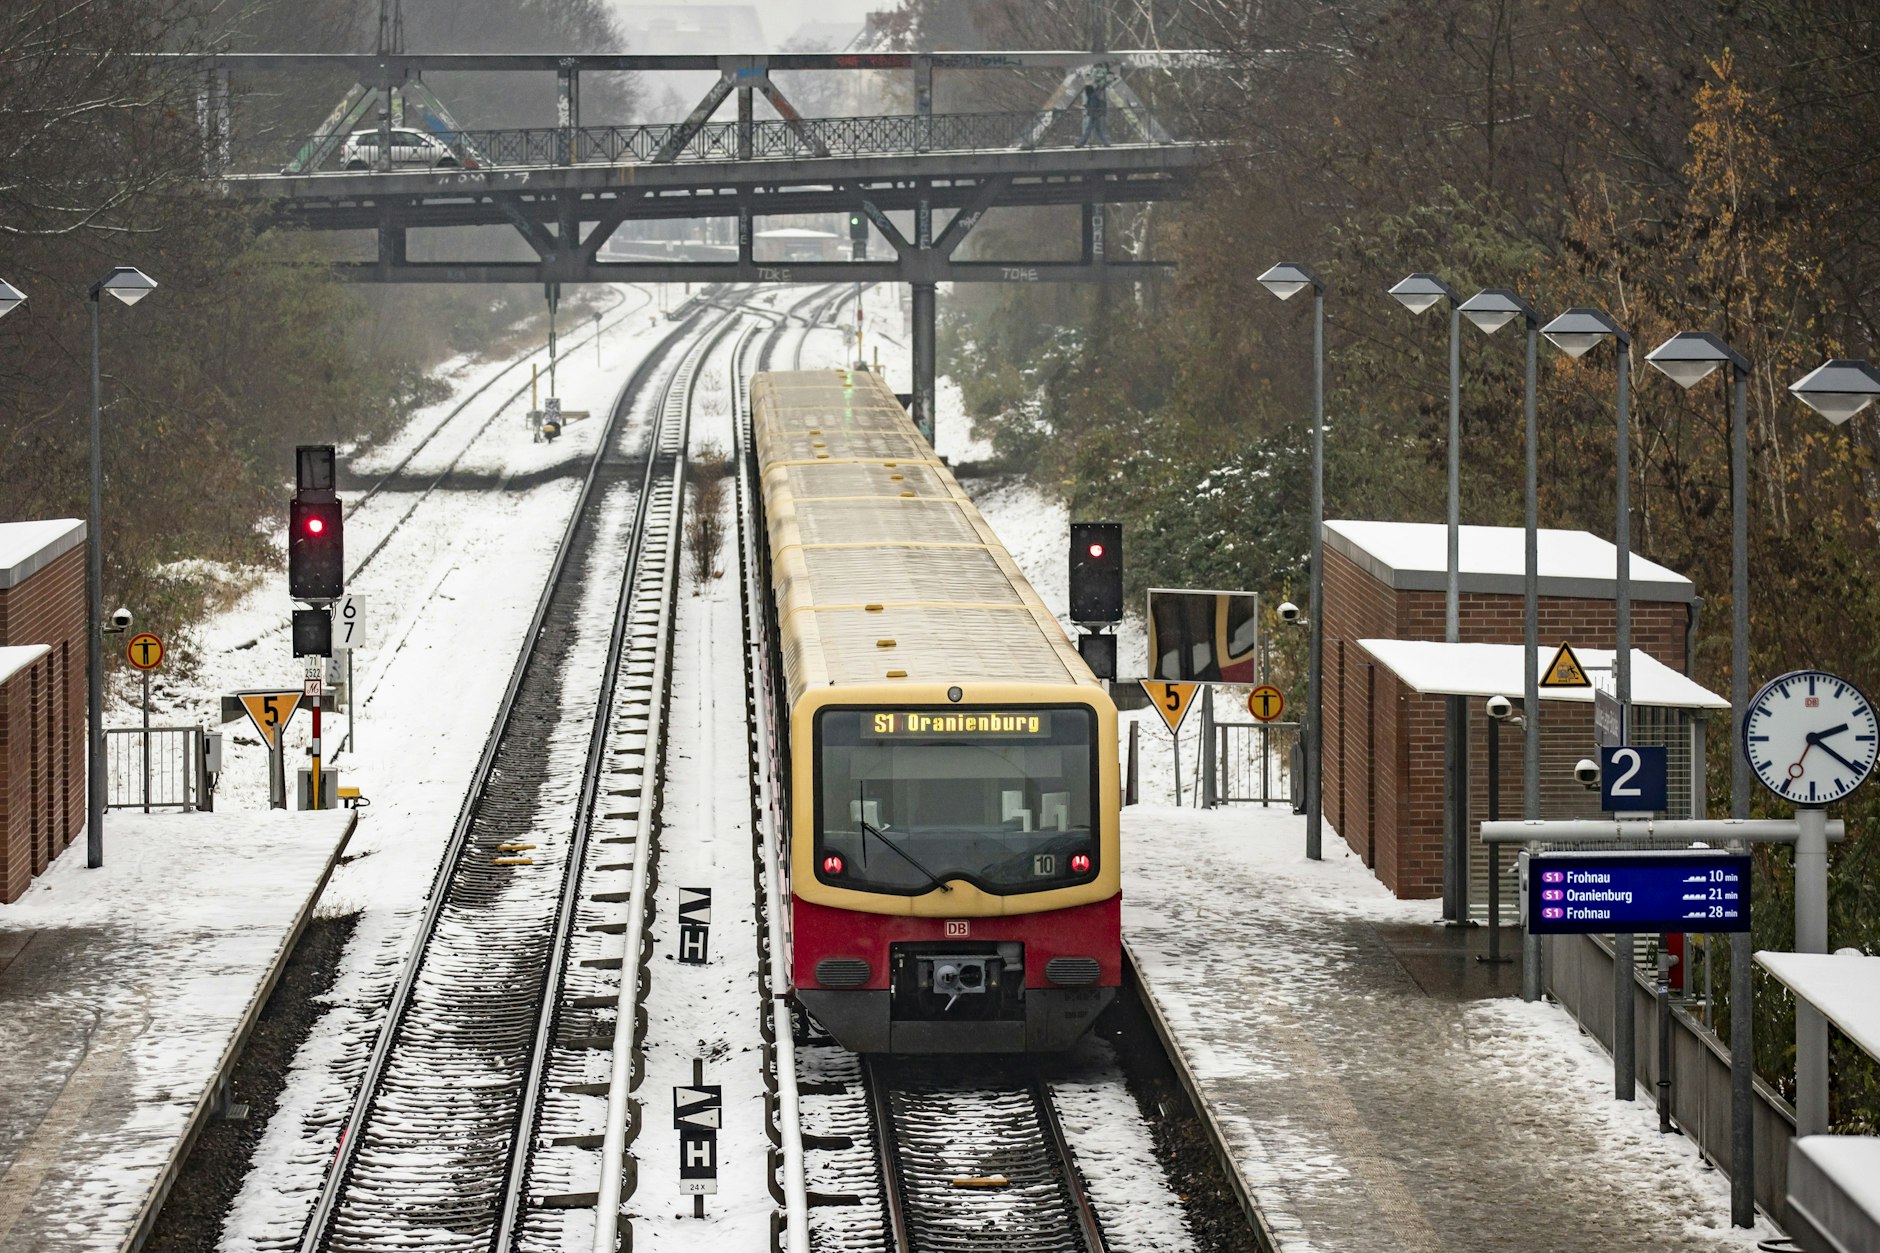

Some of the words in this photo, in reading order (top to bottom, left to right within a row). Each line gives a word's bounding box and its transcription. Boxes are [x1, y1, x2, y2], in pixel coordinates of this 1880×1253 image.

[343, 598, 356, 619] 6
[344, 622, 355, 643] 7
[309, 656, 318, 667] 71
[305, 668, 321, 678] 2522
[1165, 683, 1180, 711] 5
[1805, 698, 1819, 707] DB
[263, 695, 279, 727] 5
[874, 713, 895, 733] S1
[908, 713, 1040, 733] Oranienburg
[1610, 748, 1642, 797] 2
[1036, 856, 1053, 873] 10
[1545, 872, 1560, 882] S1
[1567, 871, 1611, 884] Frohnau
[1709, 870, 1724, 882] 10
[1725, 873, 1738, 882] min
[1545, 890, 1560, 900] S1
[1567, 889, 1632, 903] Oranienburg
[1709, 888, 1723, 900] 21
[1725, 891, 1738, 900] min
[1545, 908, 1560, 918] S1
[1567, 907, 1611, 919] Frohnau
[1709, 906, 1724, 918] 28
[1725, 909, 1738, 918] min
[947, 921, 967, 935] DB
